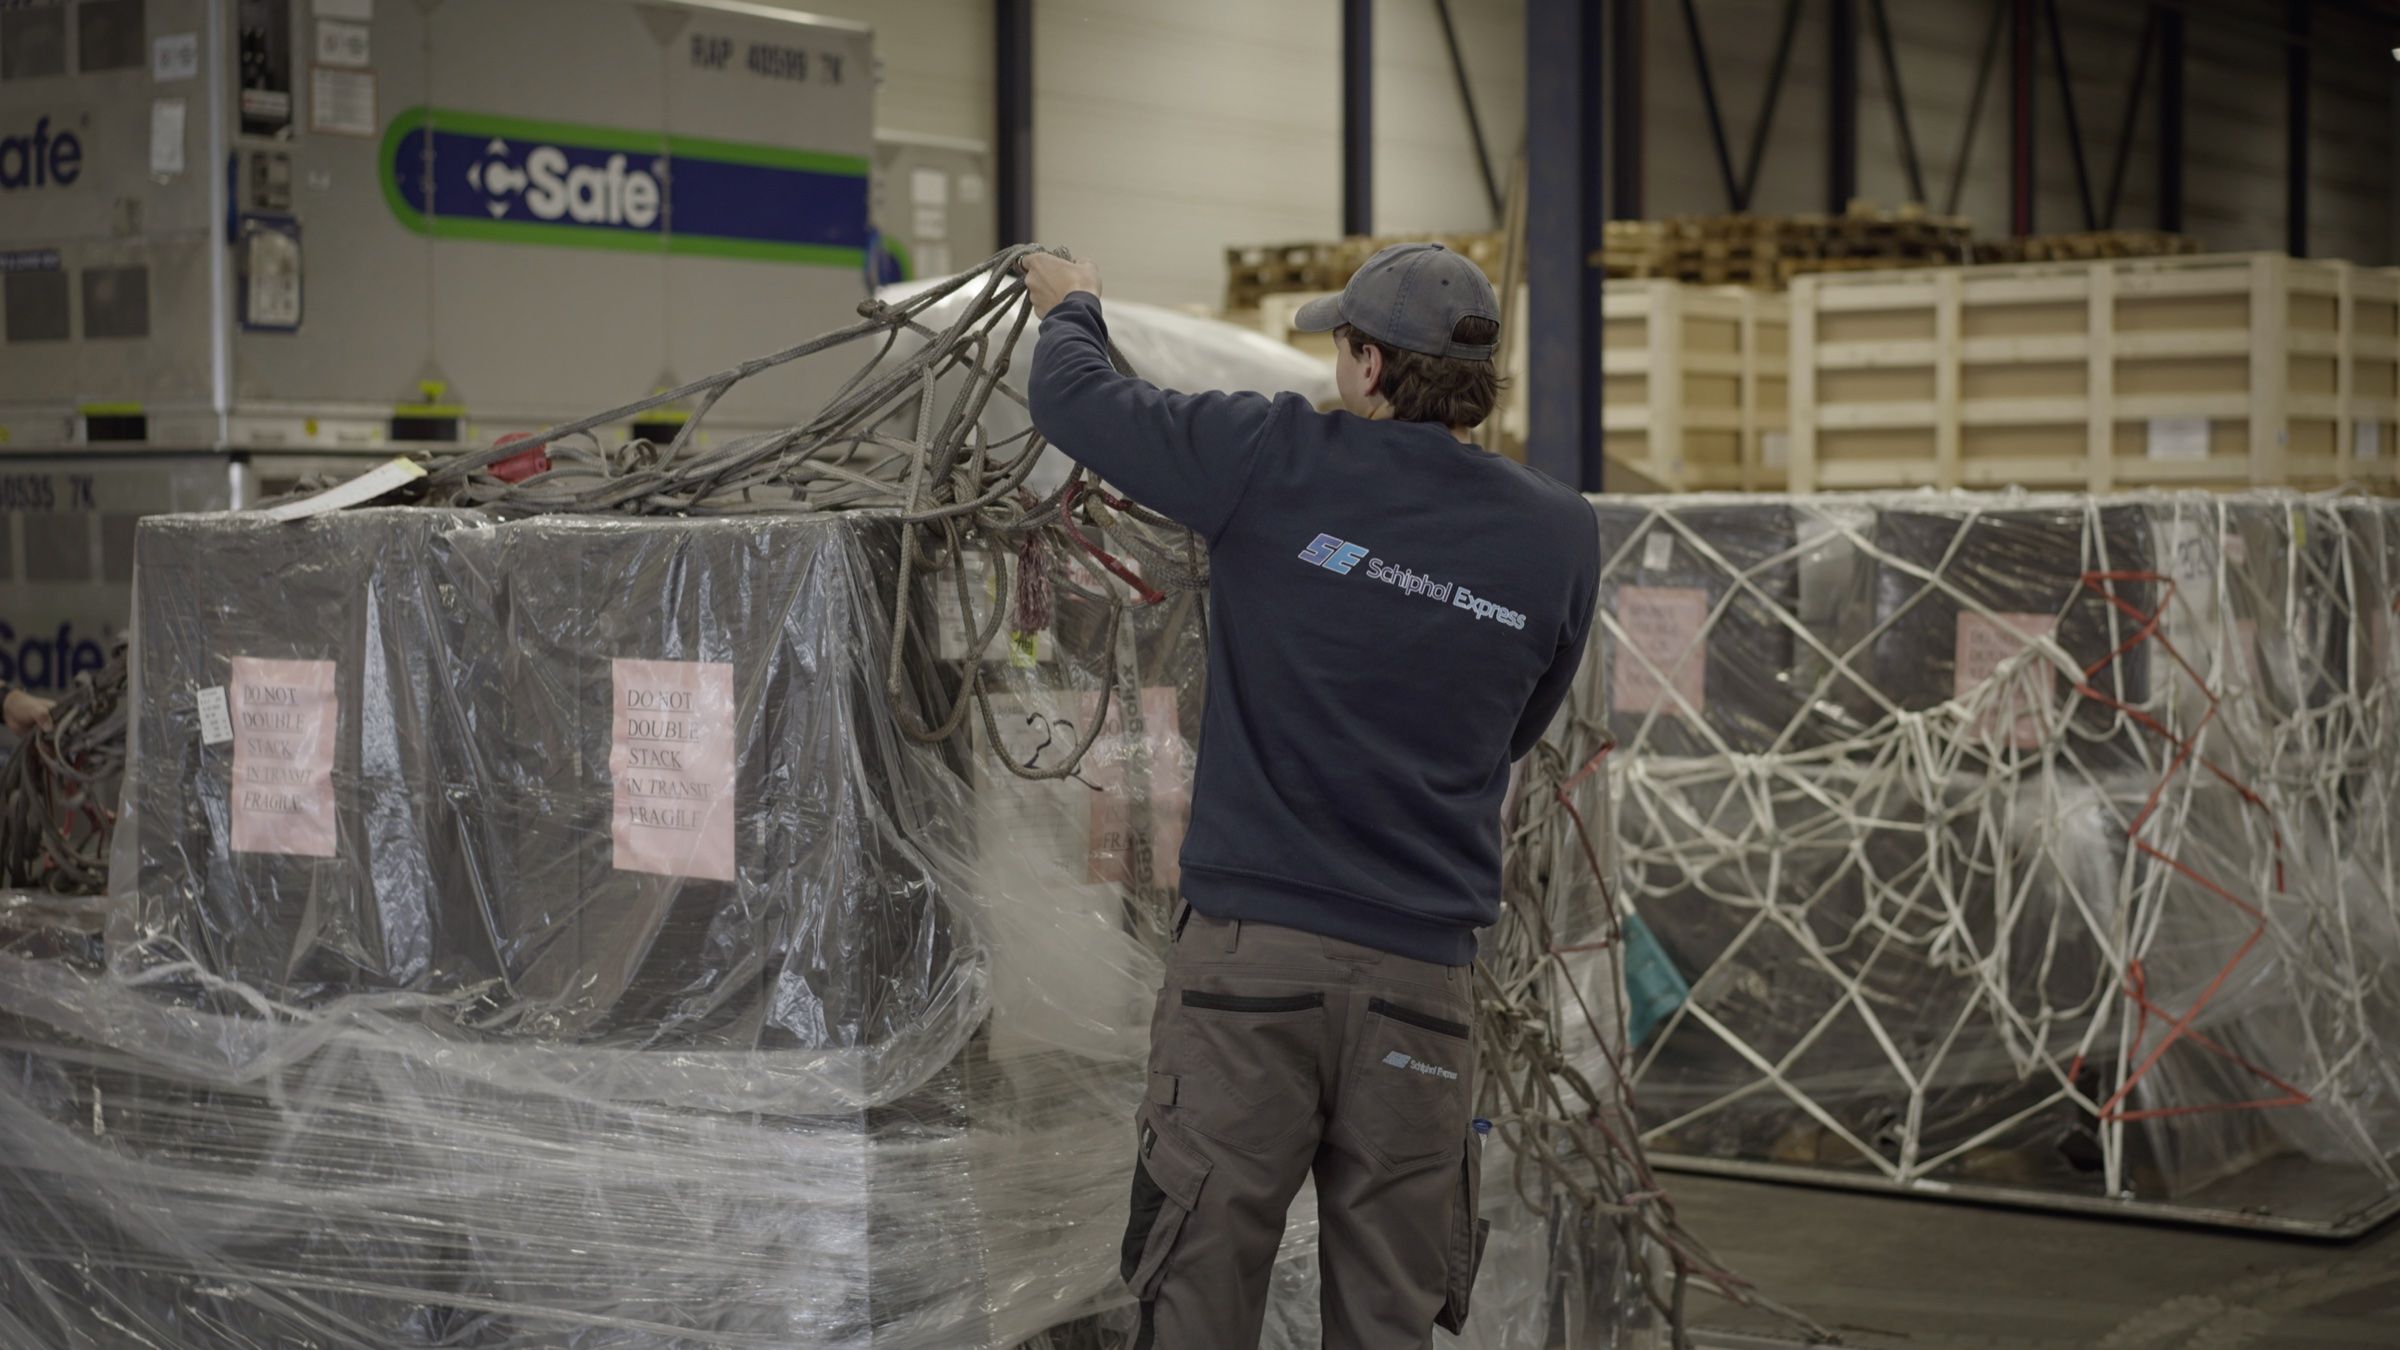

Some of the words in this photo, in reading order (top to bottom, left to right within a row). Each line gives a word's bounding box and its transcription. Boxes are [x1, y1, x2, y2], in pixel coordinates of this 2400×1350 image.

[0, 473, 56, 510] 0535
[1298, 533, 1369, 575] SE
[1366, 557, 1453, 603] Schiphol
[1453, 586, 1526, 630] Express
[244, 685, 261, 701] DO
[264, 686, 297, 703] NOT
[628, 689, 654, 707] DO
[659, 690, 693, 709] NOT
[243, 711, 304, 730] DOUBLE
[628, 719, 700, 740] DOUBLE
[247, 738, 293, 758] STACK
[628, 748, 683, 769] STACK
[627, 777, 643, 793] IN
[650, 778, 711, 799] TRANSIT
